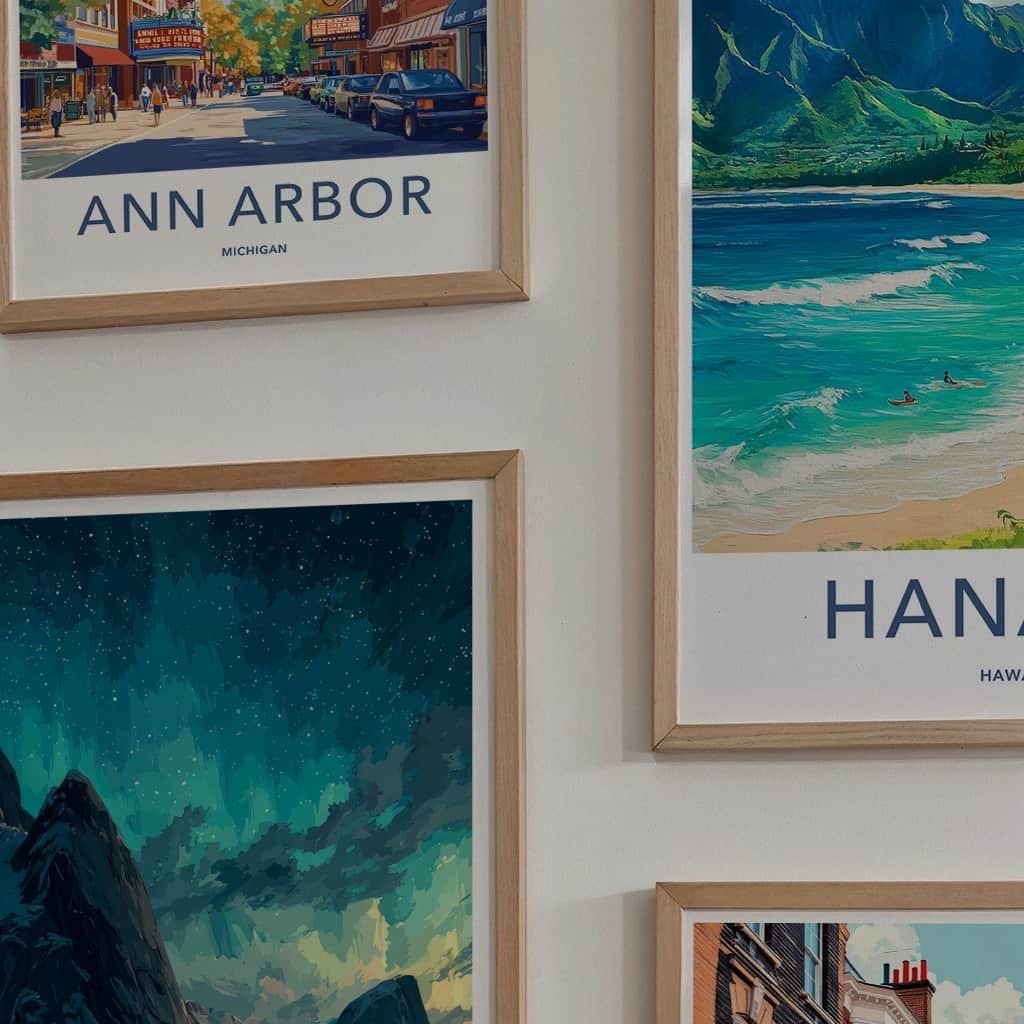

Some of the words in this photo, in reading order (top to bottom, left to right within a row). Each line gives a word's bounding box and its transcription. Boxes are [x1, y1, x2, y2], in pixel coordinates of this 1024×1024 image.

[76, 188, 205, 236] ANN
[227, 175, 432, 227] ARBOR
[221, 243, 288, 257] MICHIGAN
[826, 577, 1024, 639] HAN
